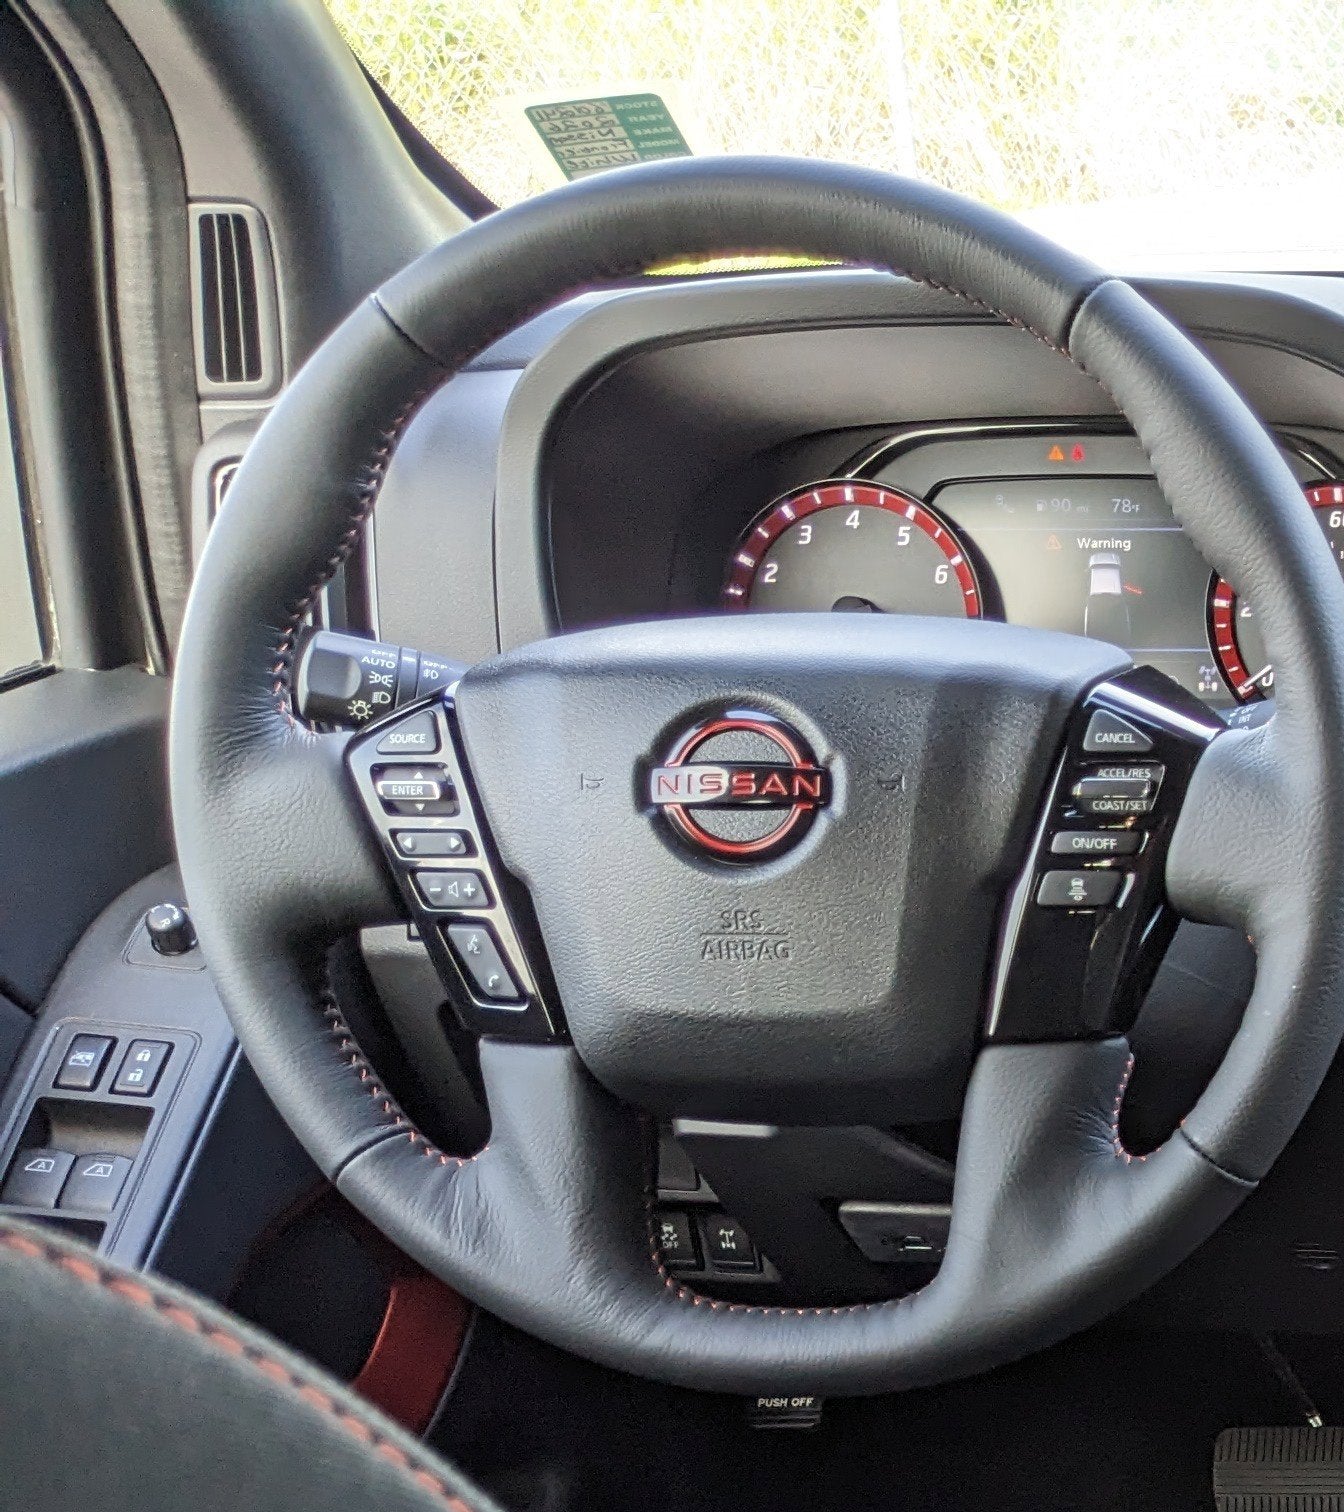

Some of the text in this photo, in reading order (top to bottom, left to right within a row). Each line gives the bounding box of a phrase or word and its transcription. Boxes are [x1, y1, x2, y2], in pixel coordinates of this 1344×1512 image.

[846, 510, 860, 529] 4
[798, 525, 812, 544] 3
[897, 526, 910, 546] 5
[1076, 537, 1131, 551] Warning
[764, 563, 778, 584] 2
[934, 565, 948, 584] 6
[361, 656, 396, 669] AUTO
[389, 733, 426, 744] SOURCE
[1095, 732, 1136, 744] CANCEL
[1097, 767, 1151, 779] ACCEL/RES
[391, 784, 424, 796] ENTER
[657, 772, 822, 797] NISSAN
[1092, 800, 1148, 811] COAST/SET
[1072, 837, 1118, 849] ON/OFF
[719, 909, 765, 931] SRS
[700, 940, 790, 961] AIRBAG
[757, 1396, 814, 1408] PUSH OFF
